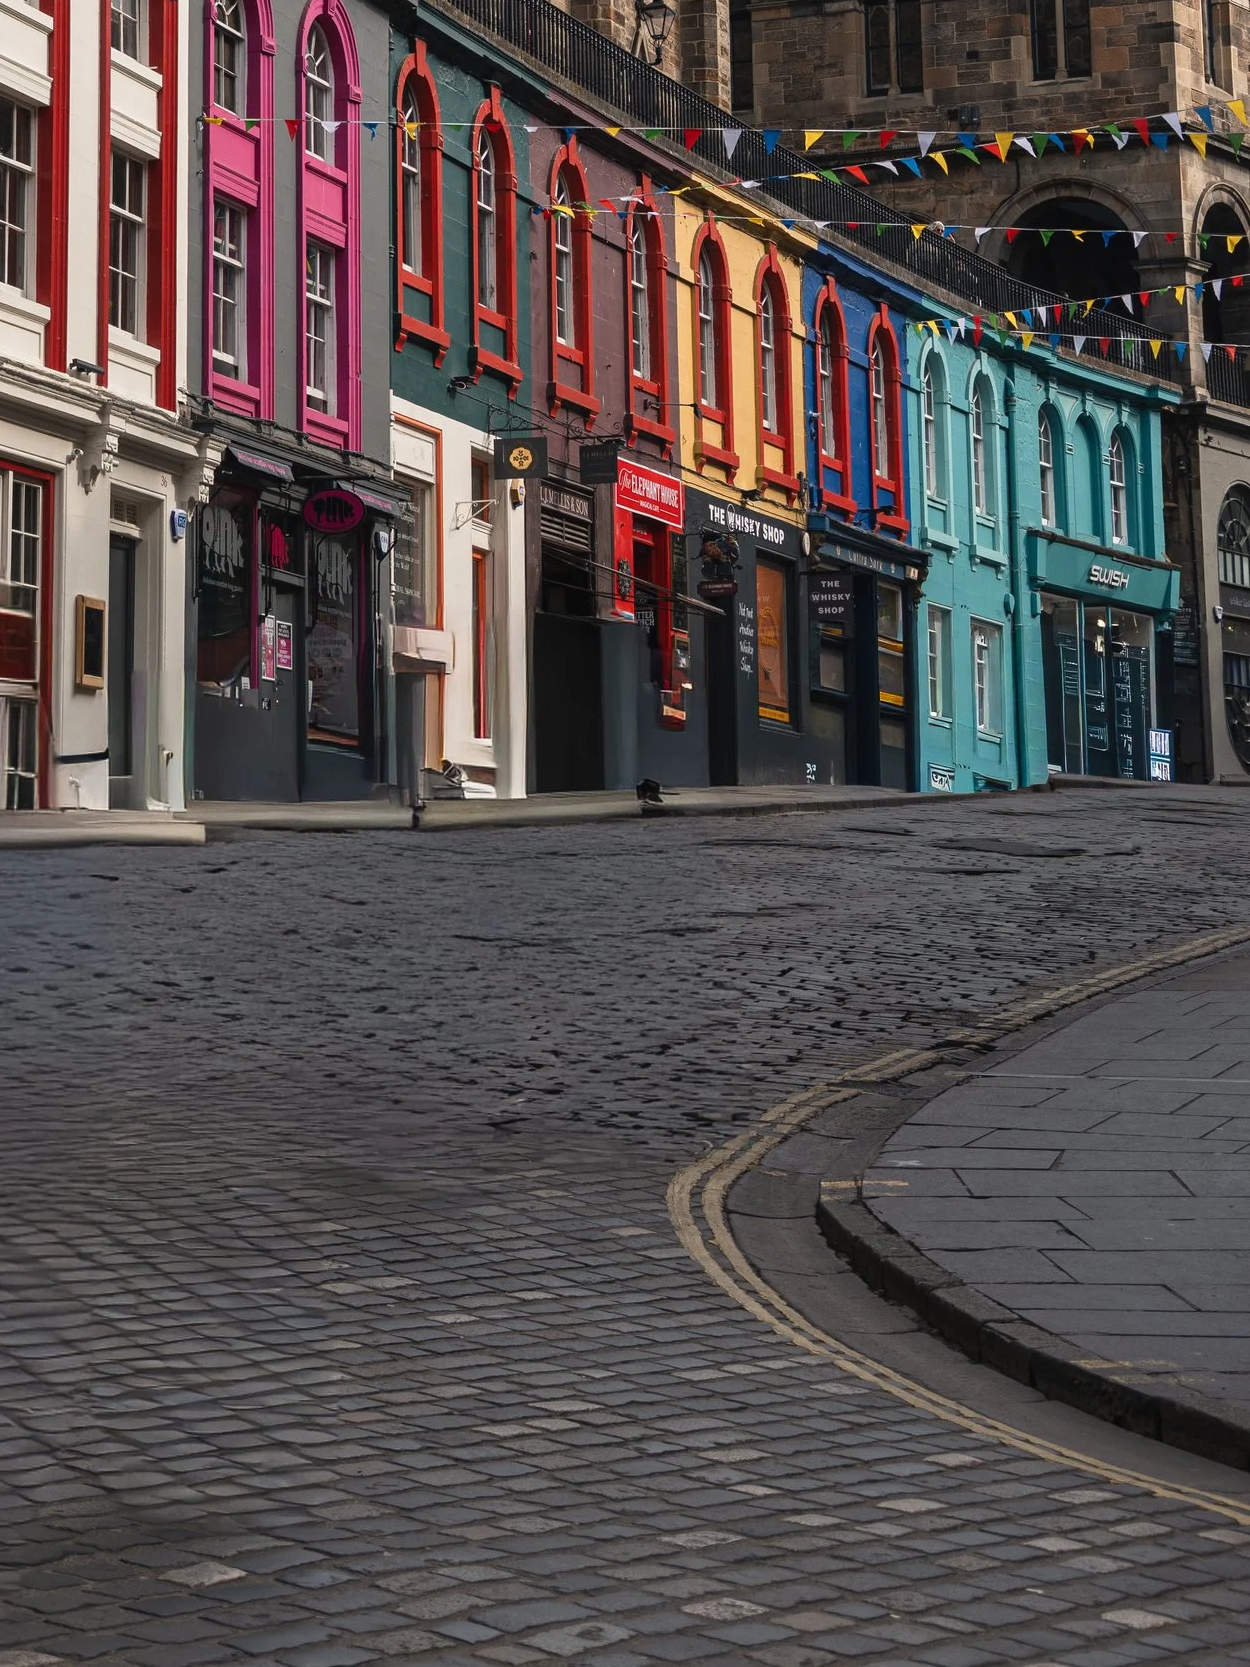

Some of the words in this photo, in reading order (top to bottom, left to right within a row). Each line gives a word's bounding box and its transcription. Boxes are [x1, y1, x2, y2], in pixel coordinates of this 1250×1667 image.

[618, 467, 633, 492] The
[631, 474, 661, 502] ELEPHANT
[660, 484, 679, 509] HOUSE
[571, 497, 576, 512] &
[576, 498, 589, 517] SON
[708, 503, 726, 526] THE
[727, 511, 761, 538] WHISKY
[762, 522, 785, 545] SHOP
[820, 580, 840, 588] THE
[1089, 564, 1130, 589] SWISH
[811, 593, 851, 601] WHISKY
[818, 606, 845, 615] SHOP
